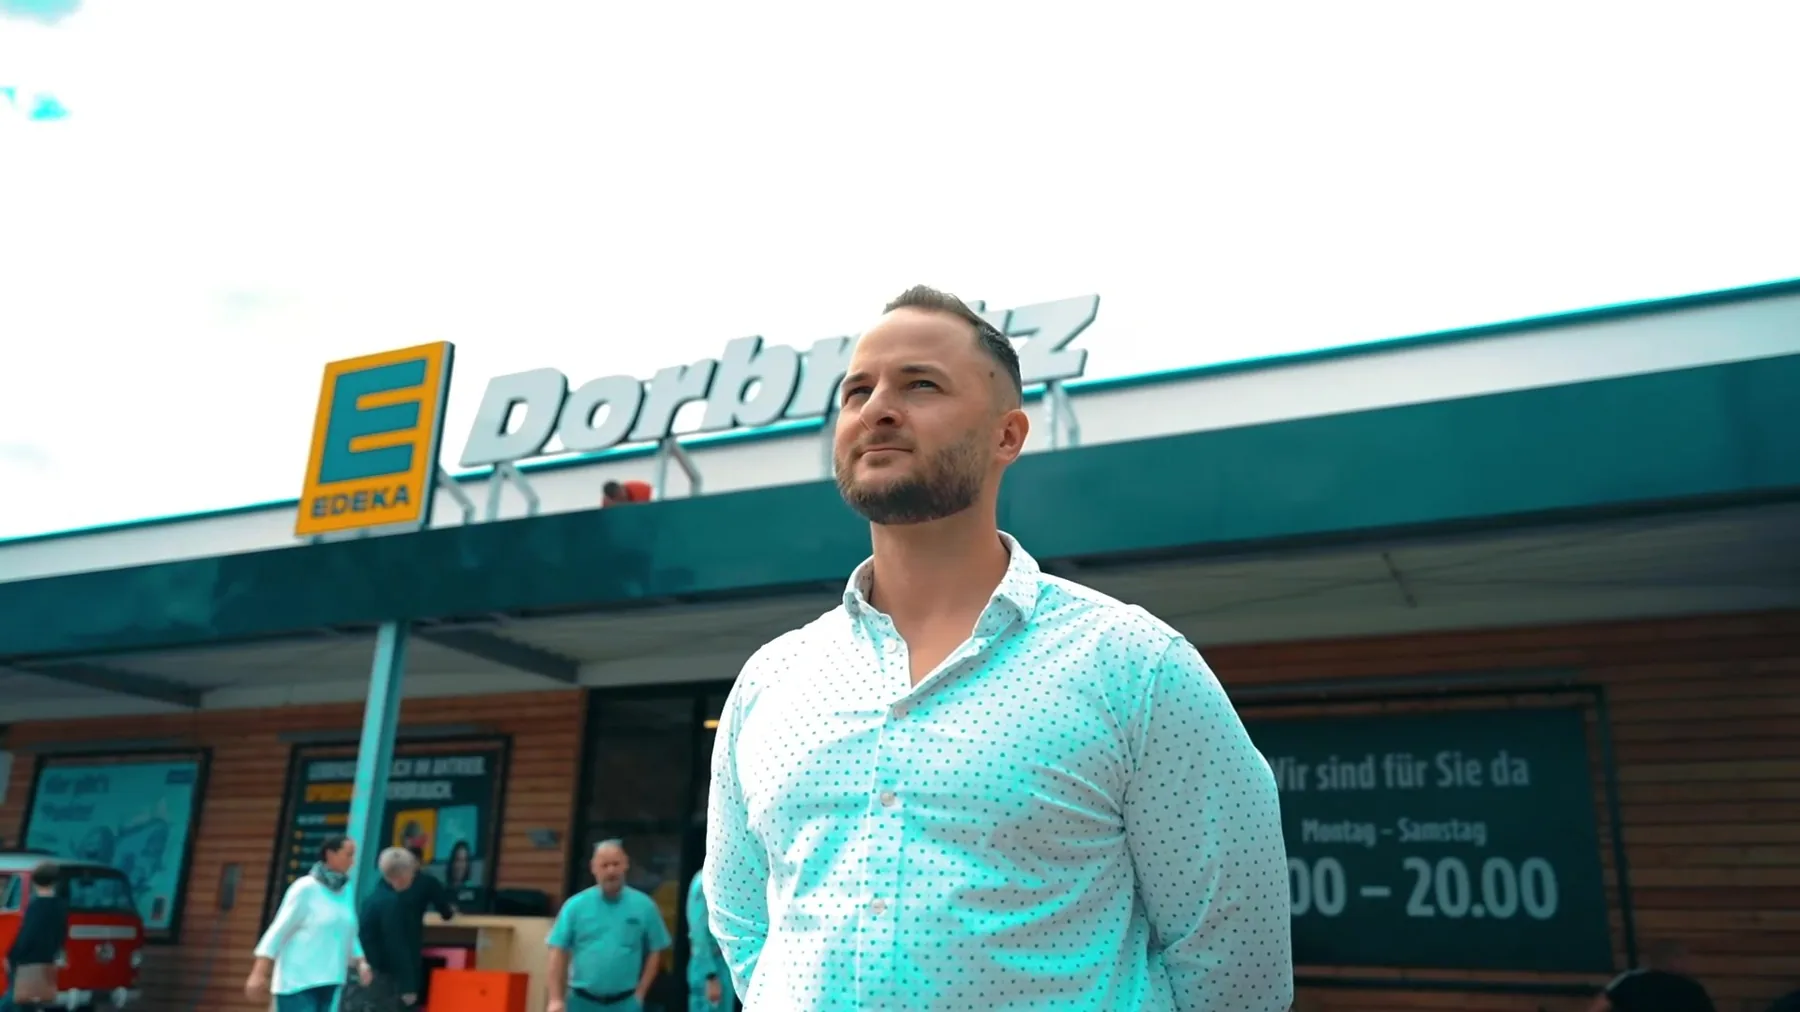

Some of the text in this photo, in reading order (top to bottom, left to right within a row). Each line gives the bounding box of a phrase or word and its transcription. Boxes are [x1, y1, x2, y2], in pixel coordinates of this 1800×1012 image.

[458, 294, 1100, 467] Dorbrz
[317, 358, 428, 485] E
[310, 484, 410, 518] EDEKA
[1315, 754, 1377, 791] sind
[1382, 752, 1429, 789] für
[1435, 751, 1483, 788] Sie
[1490, 750, 1530, 787] da
[1300, 819, 1377, 848] Montag
[1397, 817, 1488, 848] Samstag
[1402, 856, 1559, 920] 20.00
